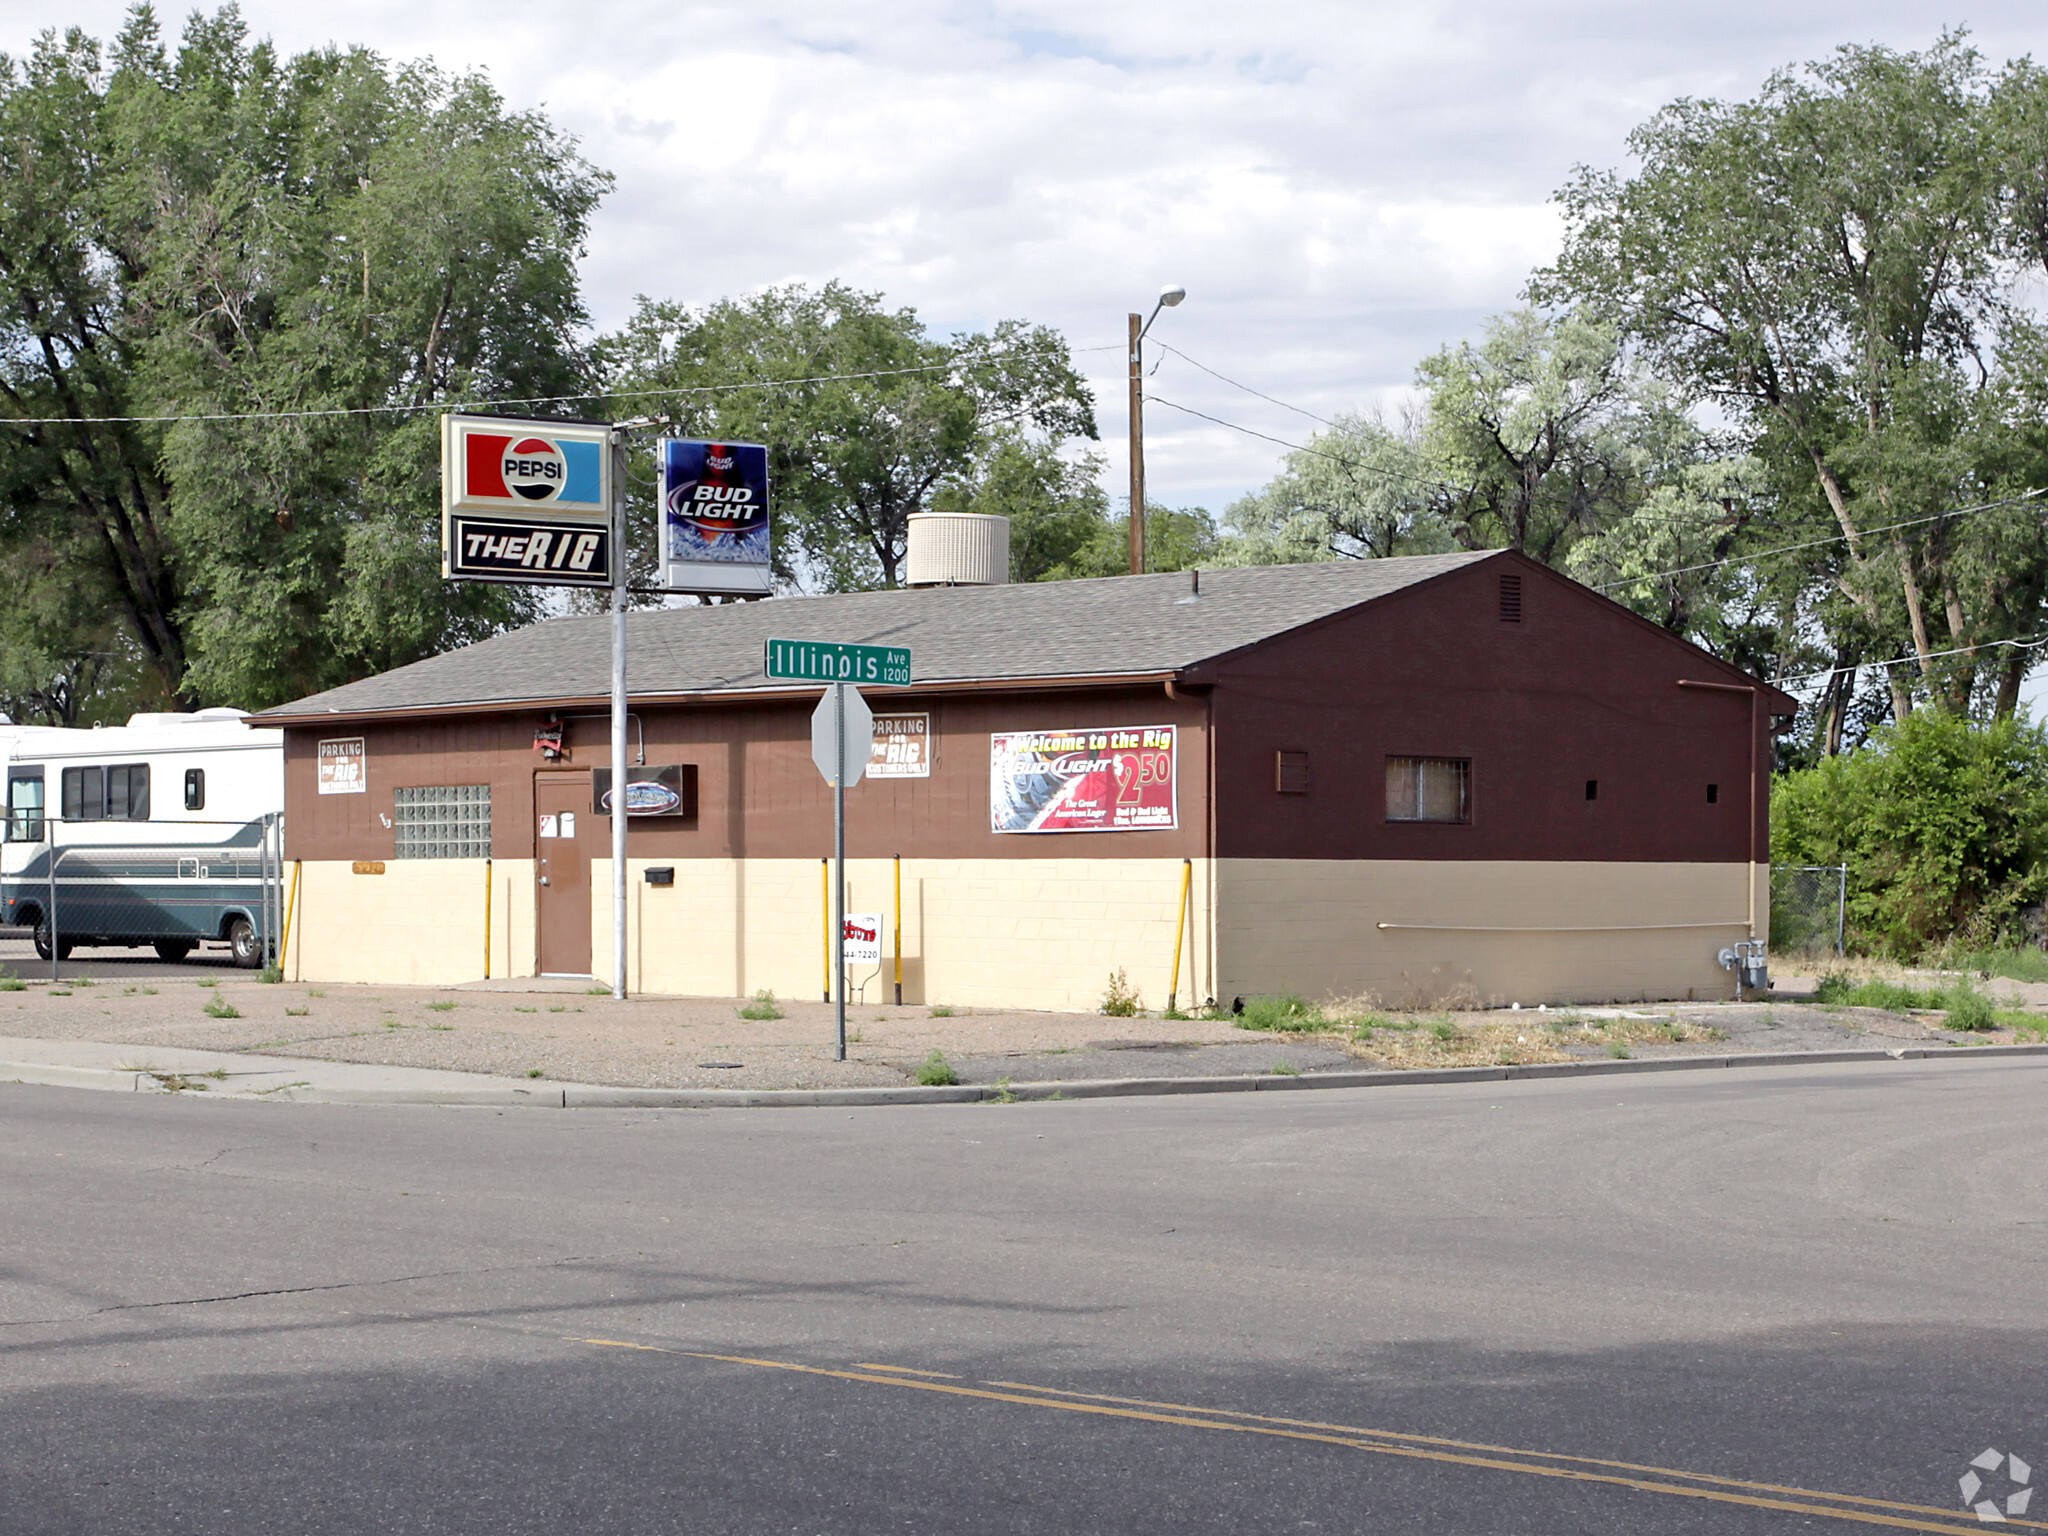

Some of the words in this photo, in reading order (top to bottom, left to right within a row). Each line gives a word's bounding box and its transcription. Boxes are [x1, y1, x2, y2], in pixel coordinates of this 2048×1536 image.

[706, 459, 734, 470] LIGHT
[709, 455, 732, 465] BUD
[505, 459, 562, 479] PEPSI
[693, 485, 753, 503] BUD
[680, 501, 760, 519] LIGHT
[465, 533, 529, 560] THE
[520, 531, 600, 571] RIG
[777, 644, 878, 679] Illinois
[886, 650, 906, 665] Ave
[883, 667, 909, 682] 1200
[872, 720, 924, 734] PARKING
[889, 734, 906, 744] FOR
[1016, 735, 1085, 753] Welcome
[1088, 733, 1108, 750] to
[1110, 731, 1140, 749] the
[1142, 730, 1172, 751] Rig
[321, 743, 361, 757] PARKING
[886, 743, 920, 763] RIG
[333, 763, 359, 781] RIG
[1012, 761, 1051, 775] BUD
[1056, 758, 1112, 773] LIGHT
[1064, 799, 1078, 808] The
[1078, 799, 1098, 808] Great
[1055, 809, 1086, 818] American
[1086, 809, 1107, 819] Lager
[843, 950, 878, 959] 44-7220
